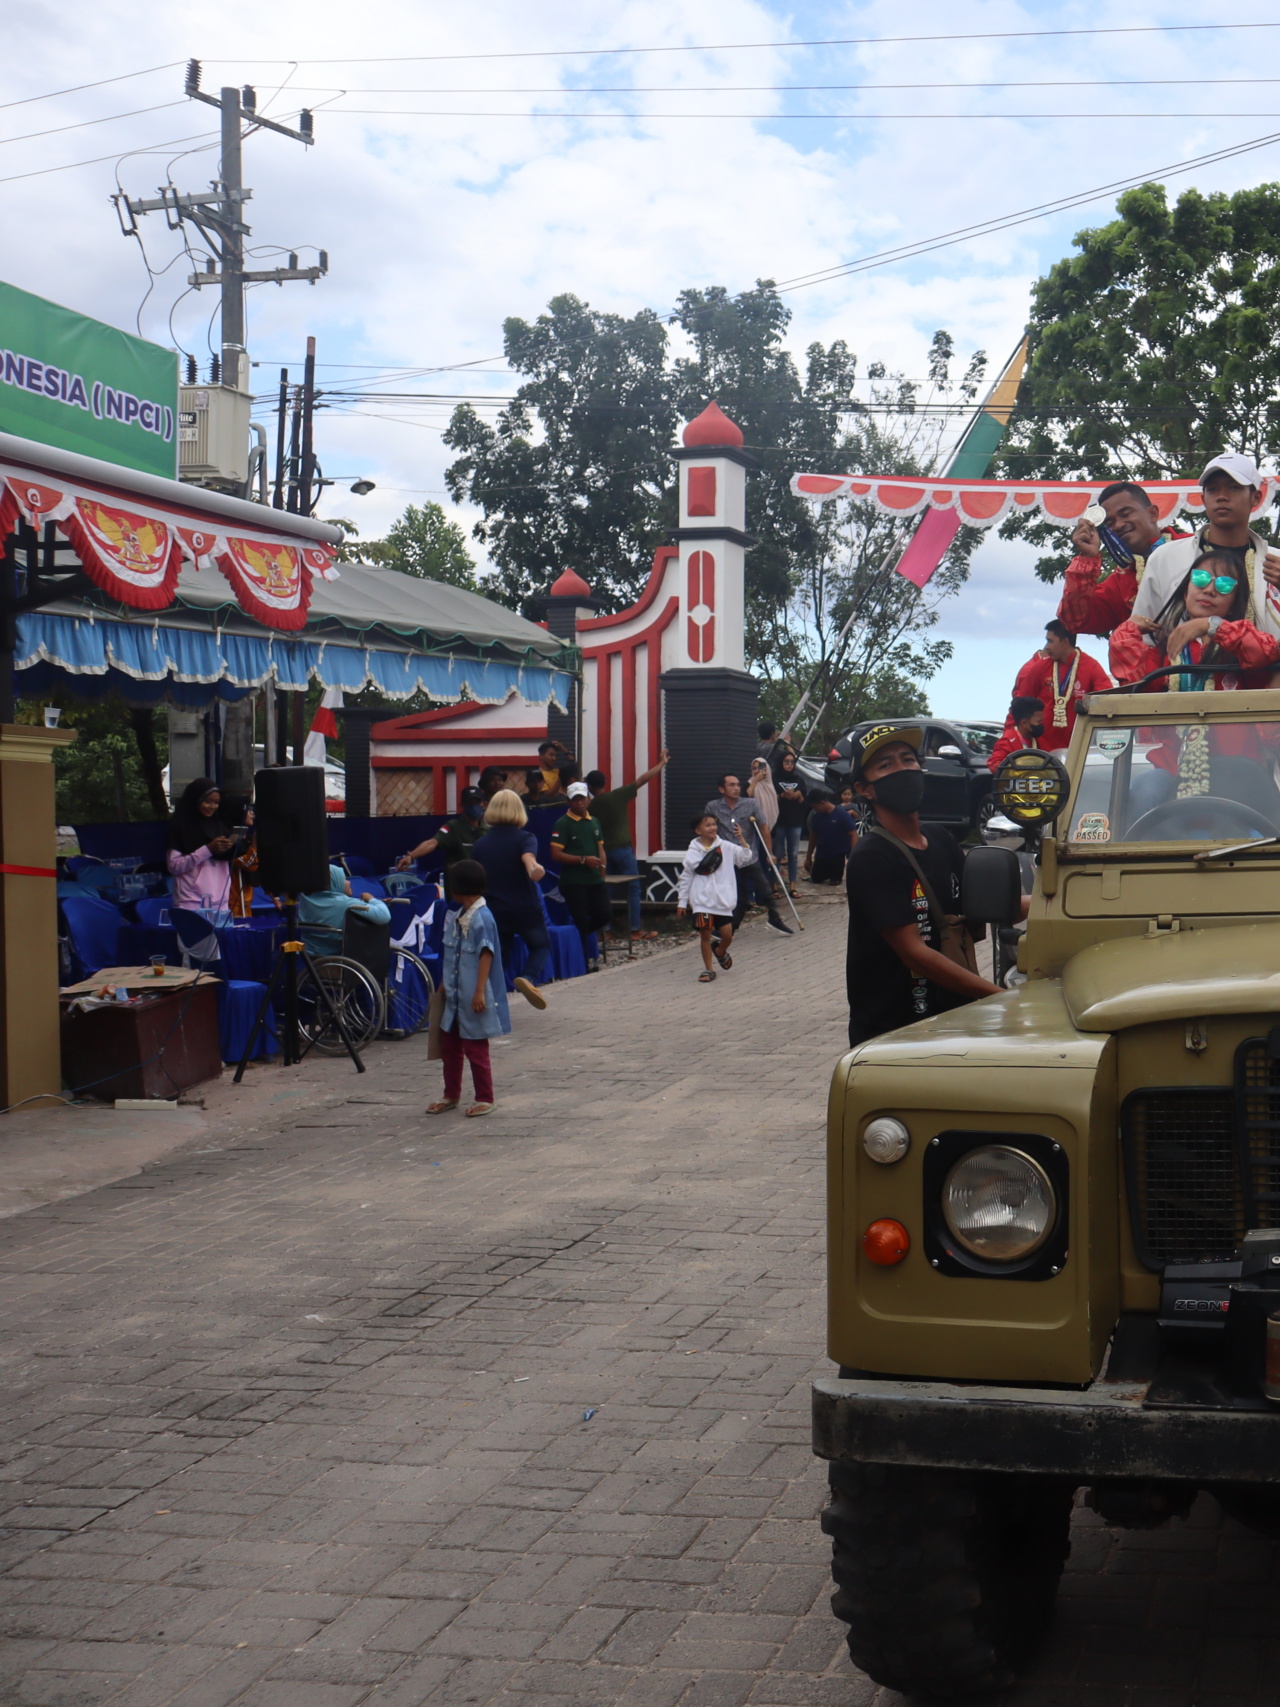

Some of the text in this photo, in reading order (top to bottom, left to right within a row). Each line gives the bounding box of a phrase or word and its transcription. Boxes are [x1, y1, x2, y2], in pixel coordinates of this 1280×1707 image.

[0, 350, 88, 411] NESIA
[1004, 779, 1055, 793] JEEP
[1076, 831, 1108, 840] PASSED
